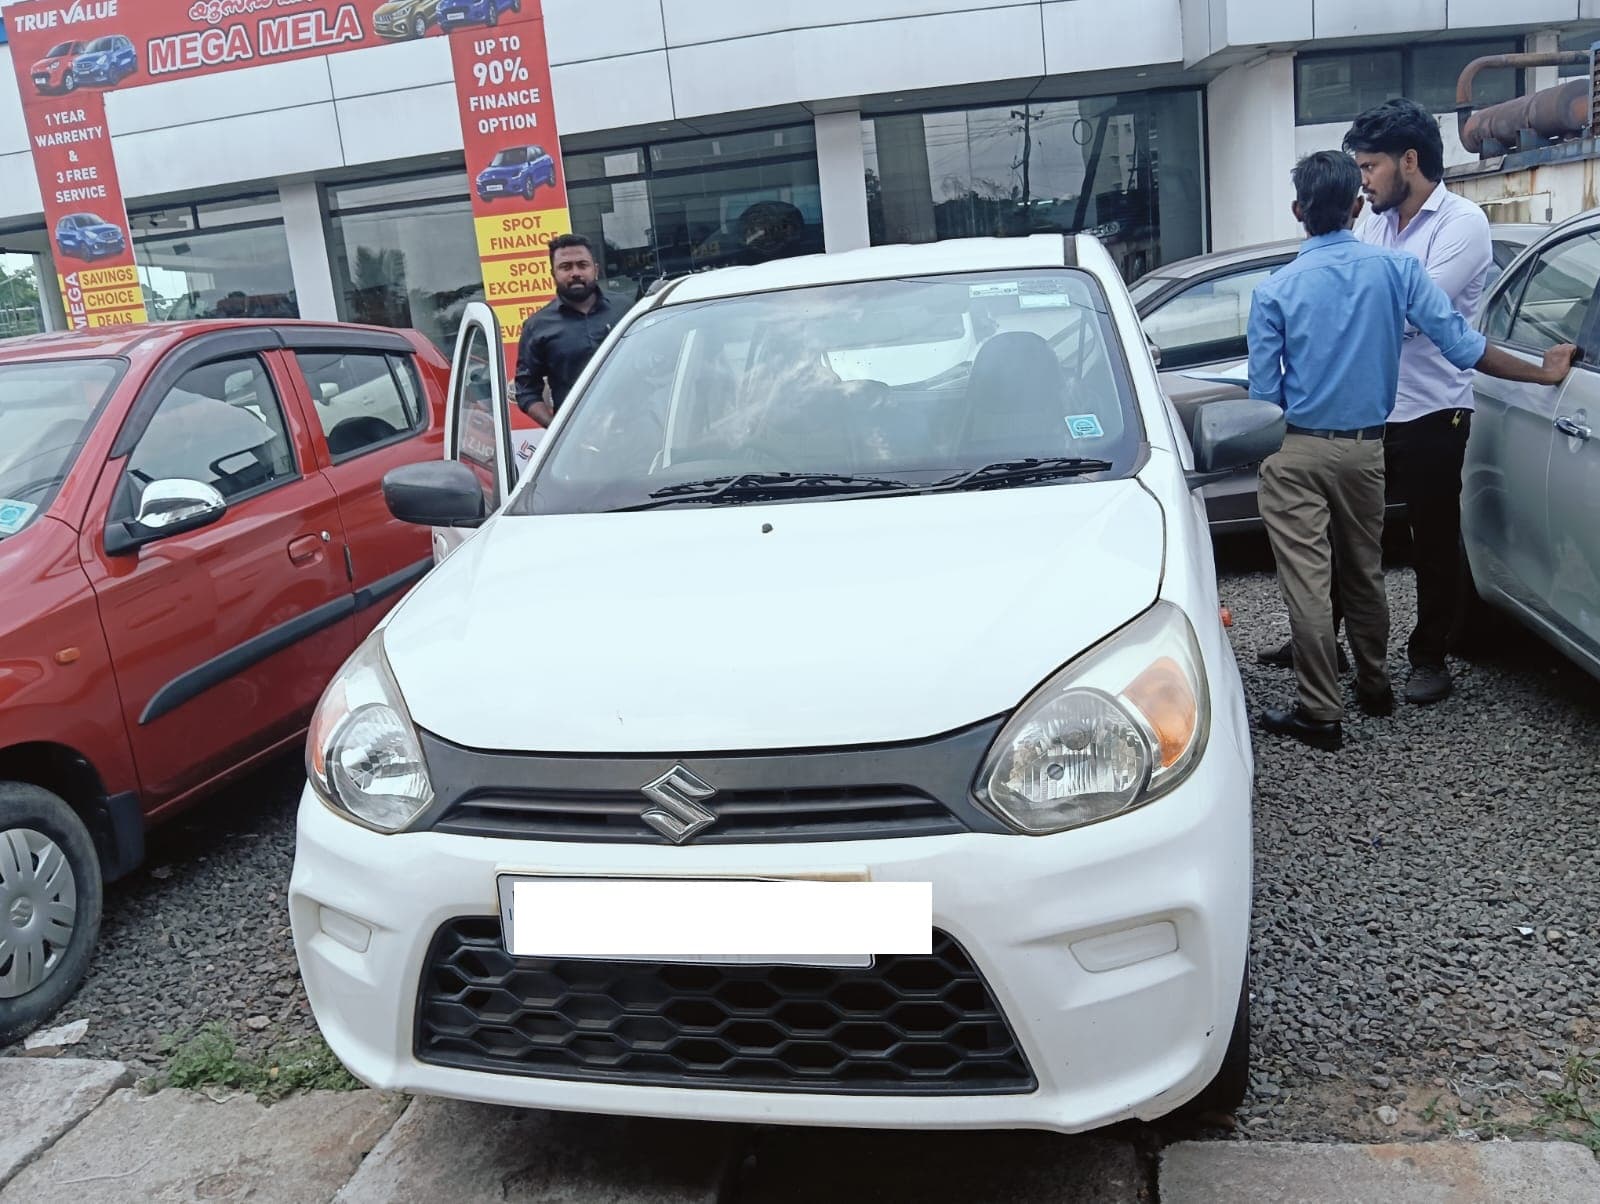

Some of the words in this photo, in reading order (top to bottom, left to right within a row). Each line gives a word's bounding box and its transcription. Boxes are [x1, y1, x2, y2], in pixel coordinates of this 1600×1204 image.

[15, 10, 57, 32] TRUE
[60, 0, 117, 24] VALUE
[149, 25, 253, 74] MEGA
[259, 5, 363, 55] MELA
[474, 40, 496, 56] UP
[500, 36, 520, 51] TO
[473, 57, 529, 87] 90%
[470, 88, 540, 111] FINANCE
[45, 114, 51, 126] 1
[53, 109, 86, 125] YEAR
[478, 113, 537, 134] OPTION
[35, 126, 102, 147] WARRENTY
[68, 150, 79, 162] &
[56, 171, 64, 183] 3
[66, 167, 97, 182] FREE
[56, 185, 106, 203] SERVICE
[502, 216, 541, 232] SPOT
[82, 268, 133, 286] SAVINGS
[510, 261, 547, 277] SPOT
[489, 277, 553, 295] EXCHAN
[65, 272, 87, 330] MEGA
[88, 290, 134, 307] CHOICE
[97, 312, 133, 327] DEALS
